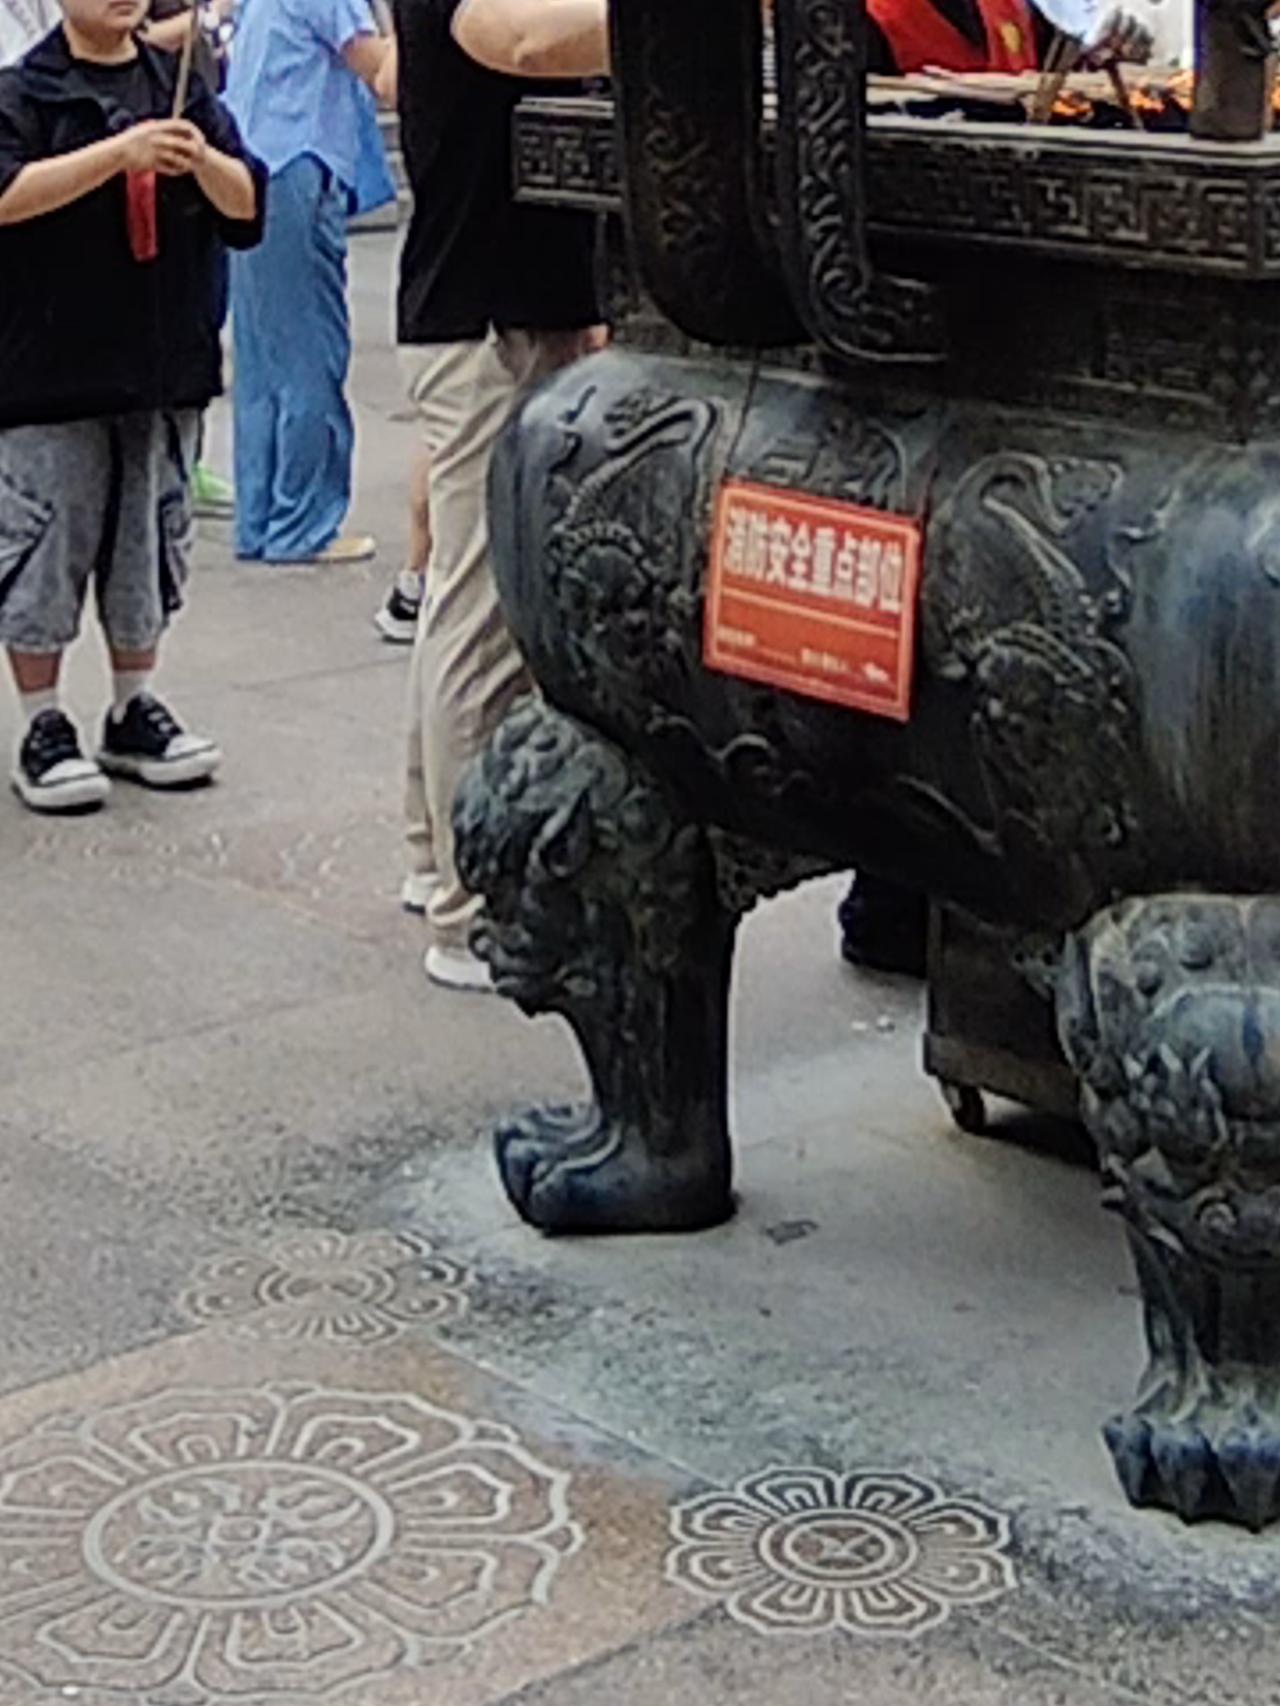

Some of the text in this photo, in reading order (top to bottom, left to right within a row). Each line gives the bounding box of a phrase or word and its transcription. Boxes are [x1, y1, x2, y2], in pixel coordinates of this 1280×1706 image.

[723, 506, 902, 614] 消防安全重点部位
